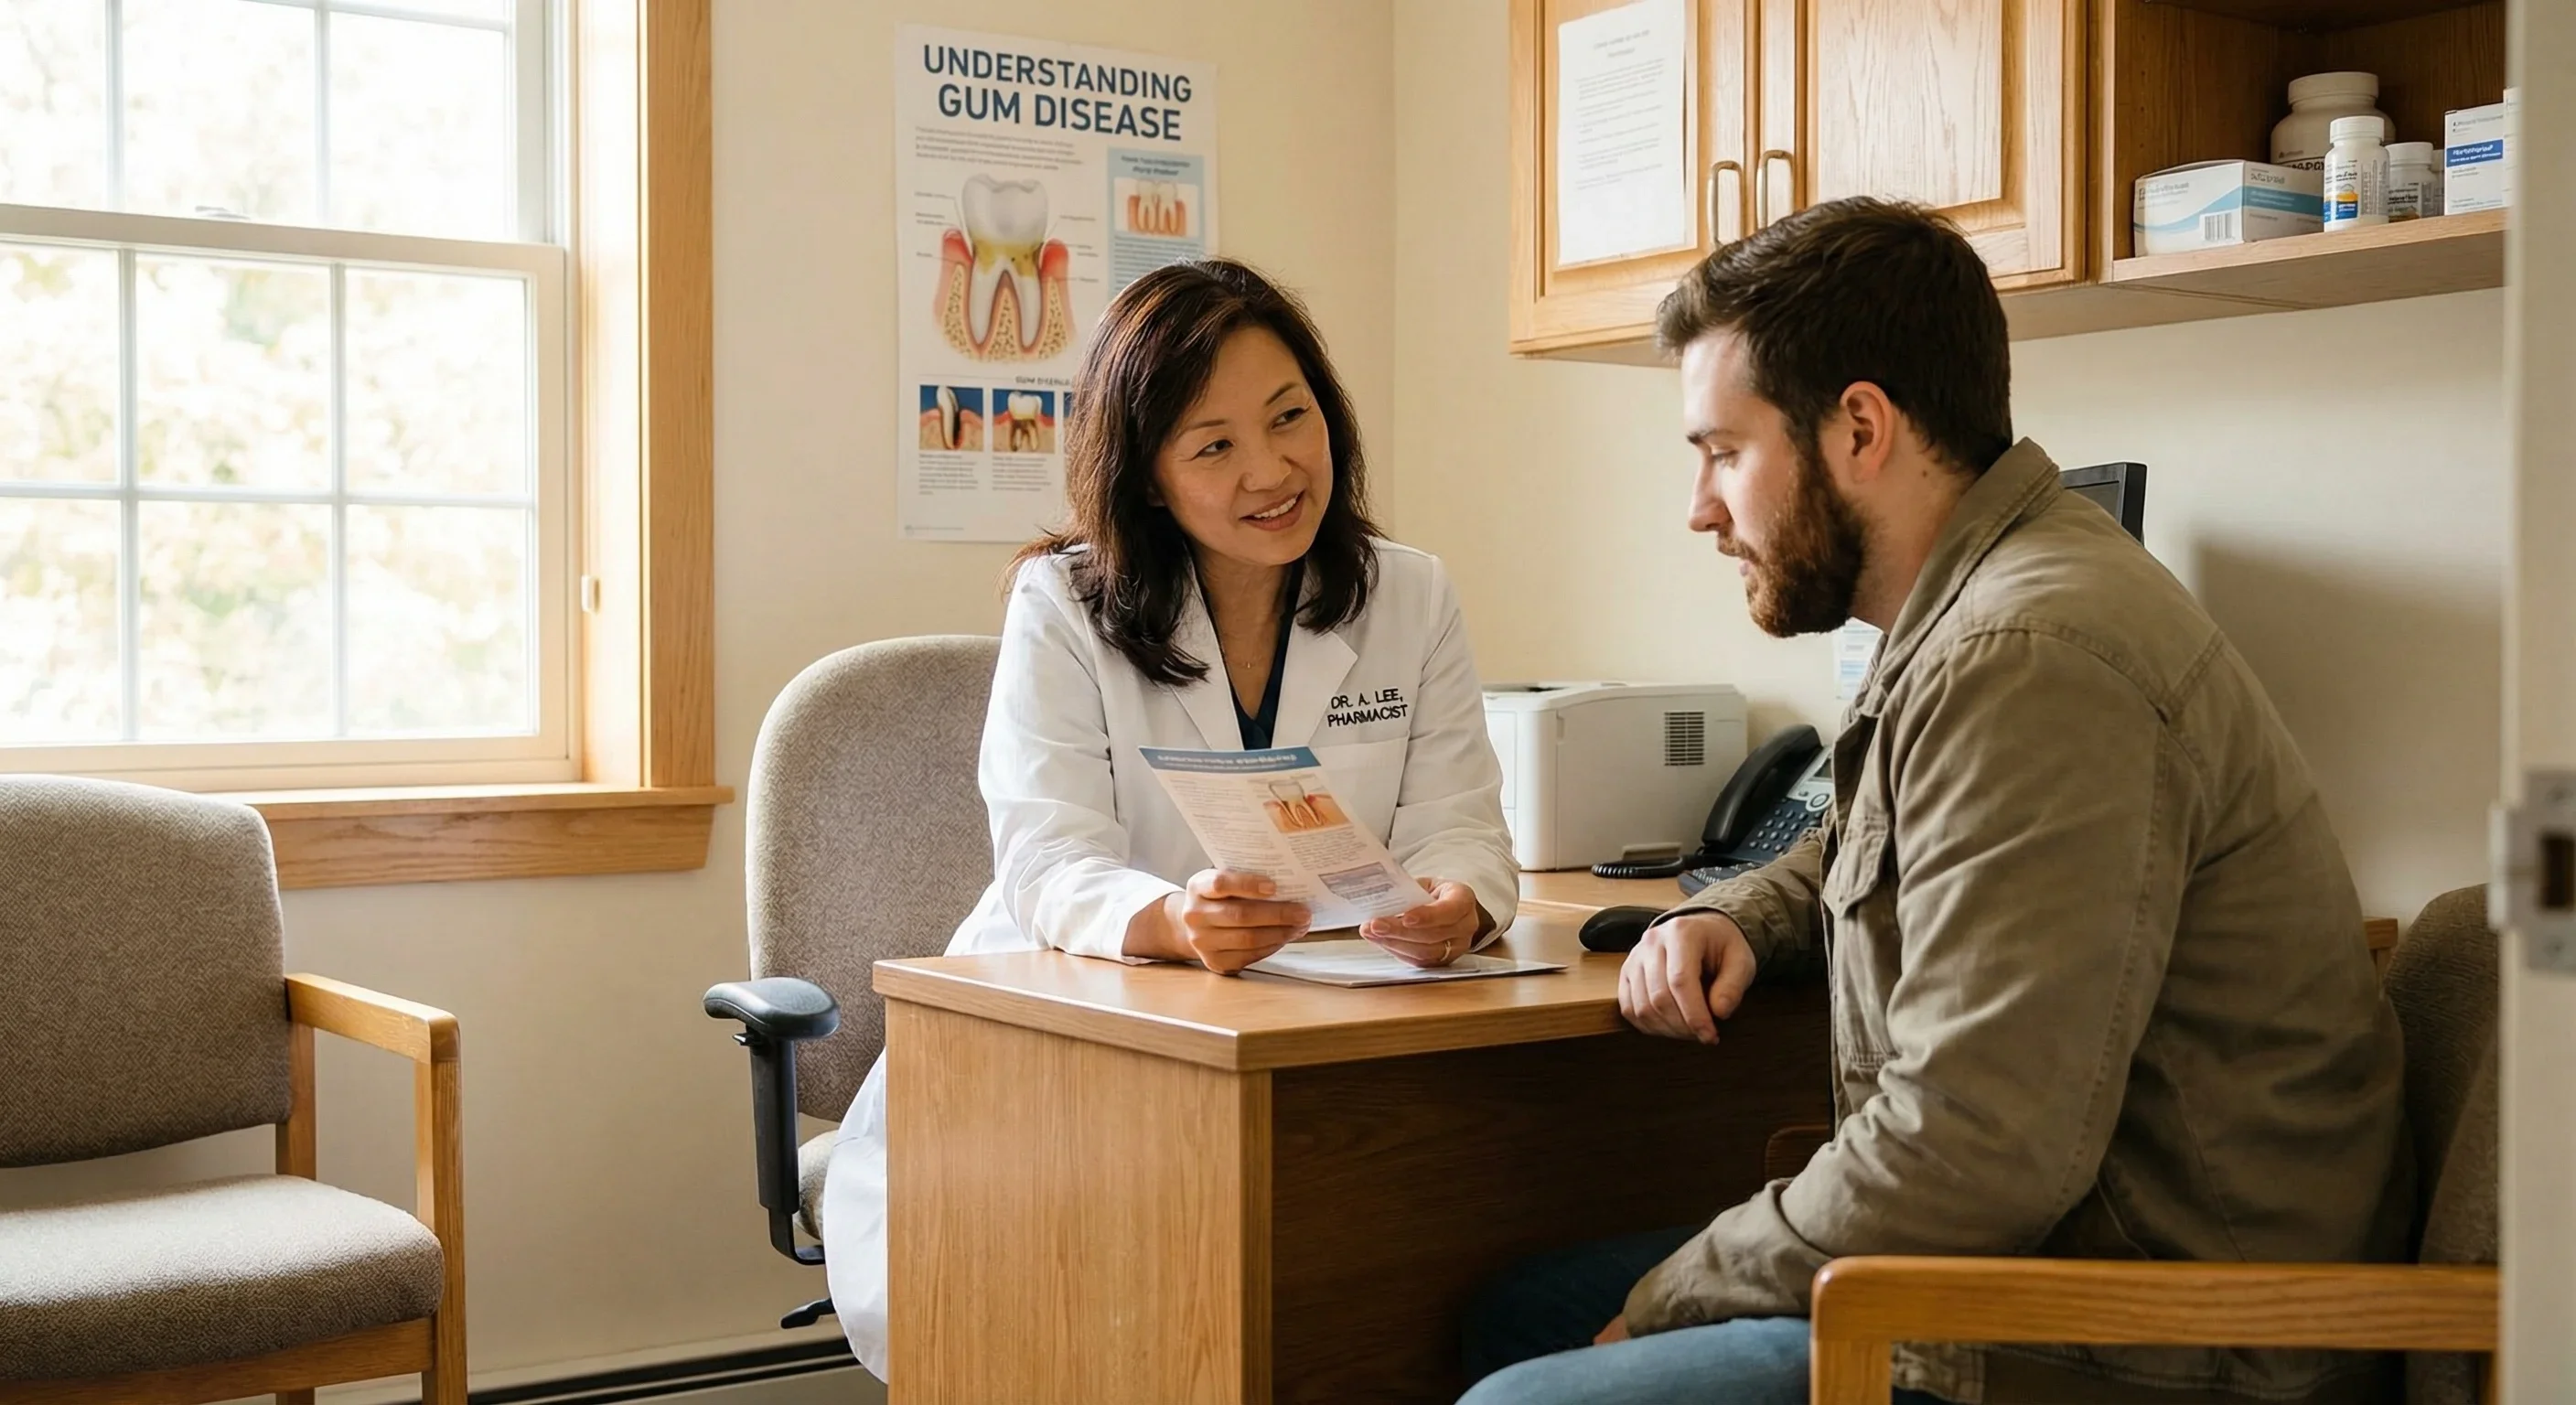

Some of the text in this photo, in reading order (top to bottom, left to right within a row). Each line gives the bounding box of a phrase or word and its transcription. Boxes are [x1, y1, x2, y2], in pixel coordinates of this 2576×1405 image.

[923, 44, 1192, 103] UNDERSTANDING
[939, 83, 1182, 142] GUM DISEASE
[1327, 704, 1408, 727] PHARMACIST
[1358, 692, 1370, 706] A.
[1375, 688, 1403, 703] LEE,
